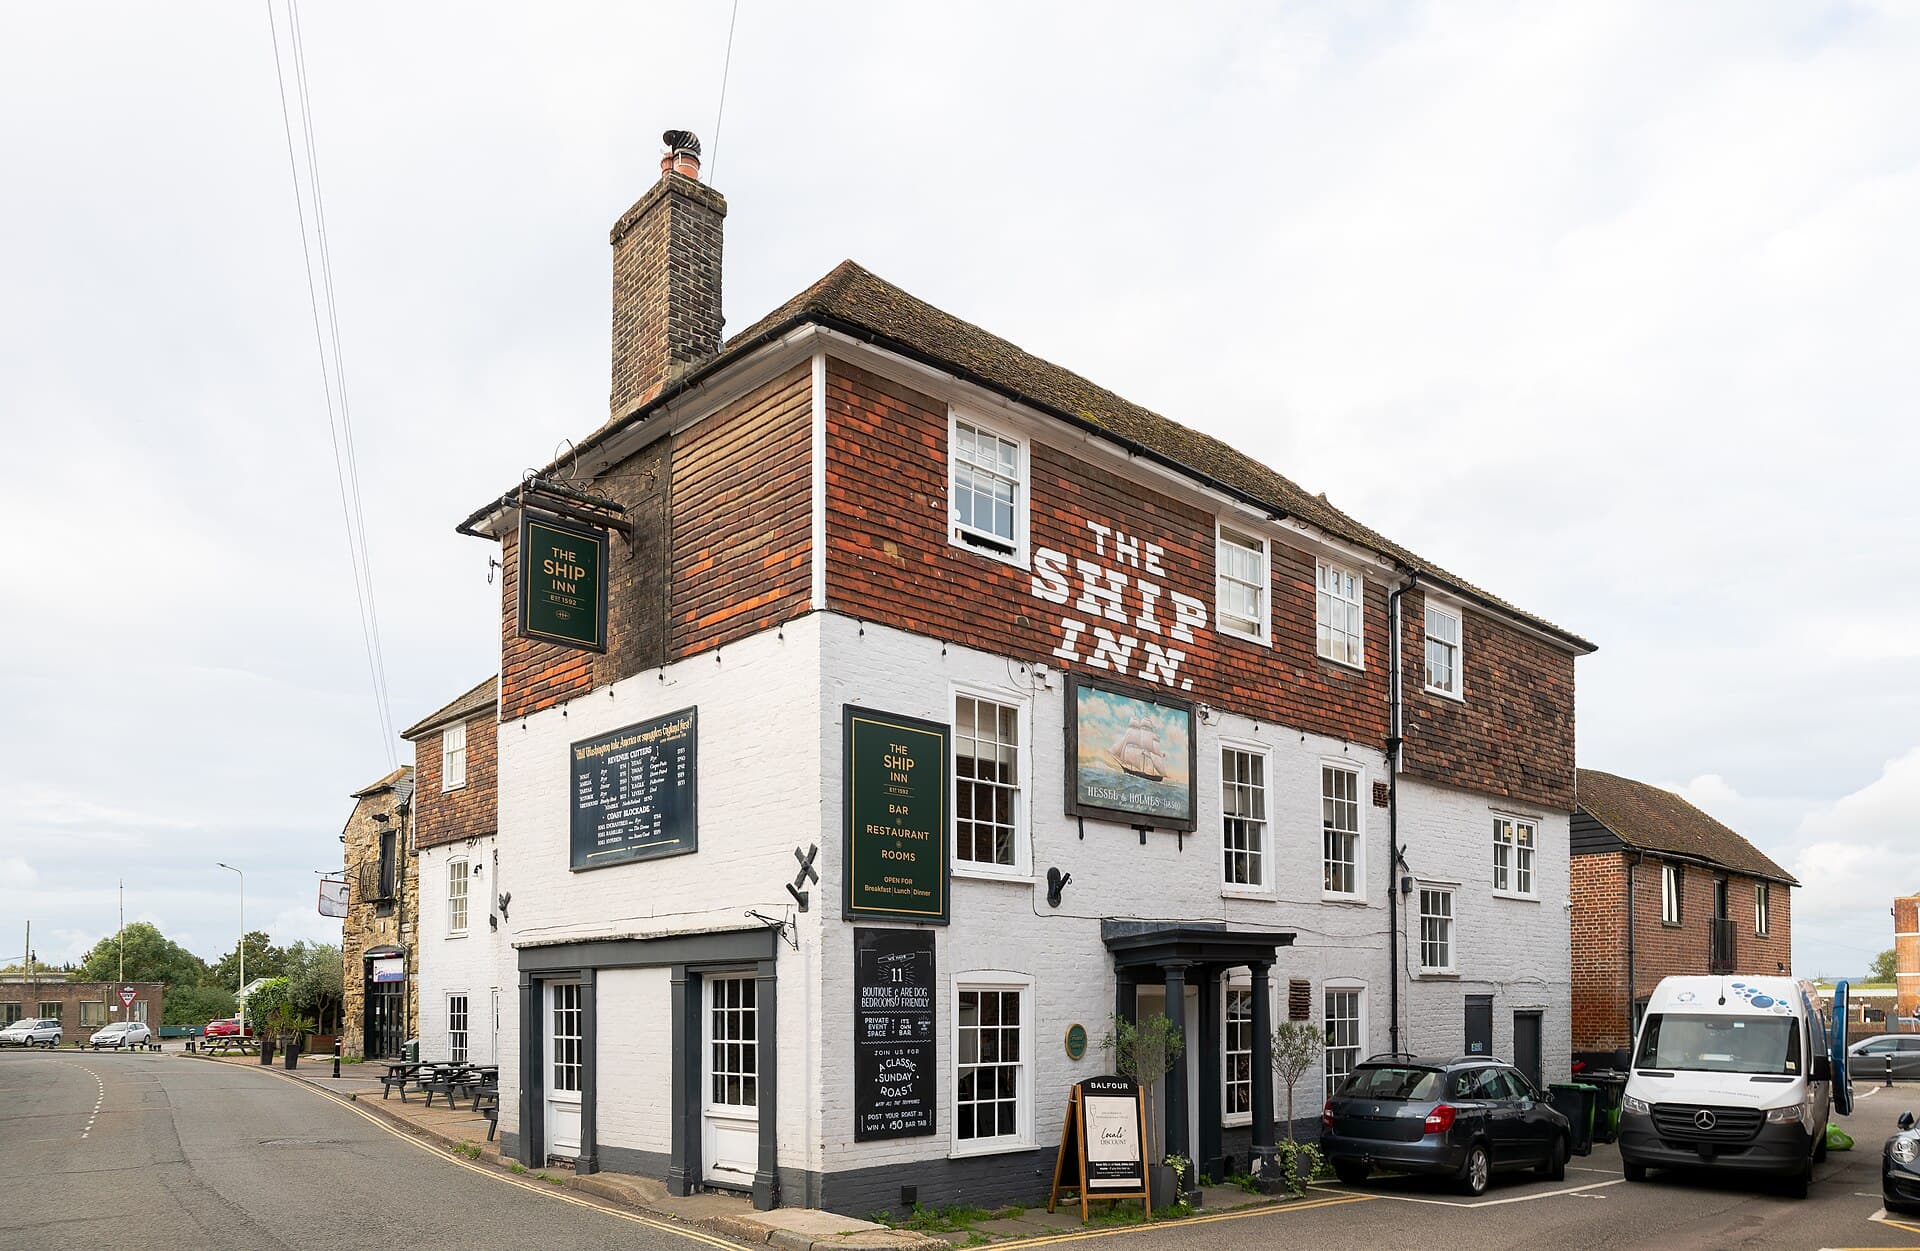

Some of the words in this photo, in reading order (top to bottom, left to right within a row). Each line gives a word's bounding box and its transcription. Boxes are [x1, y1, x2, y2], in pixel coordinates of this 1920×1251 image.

[551, 546, 577, 563] THE
[1086, 519, 1167, 578] THE
[543, 559, 586, 581] SHIP
[552, 579, 576, 595] INN
[1031, 546, 1208, 645] SHIP
[1052, 617, 1194, 691] INN.
[629, 745, 653, 759] CUTTERS
[889, 743, 909, 756] THE
[883, 754, 915, 772] SHIP
[890, 771, 908, 784] INN
[1086, 785, 1119, 802] HESSEL
[1129, 792, 1161, 808] HOLMES
[623, 805, 651, 818] BLOCKADE
[889, 803, 909, 816] BAR
[866, 824, 930, 841] RESTAURANT
[881, 849, 916, 862] ROOMS
[884, 876, 901, 885] OPEN
[901, 877, 913, 886] FOR
[864, 884, 891, 894] Breakfast
[893, 887, 911, 895] Lunch
[912, 888, 931, 897] Dinner
[890, 967, 904, 983] 11
[862, 986, 893, 998] BOUTIQUE
[900, 987, 914, 998] ARE
[914, 987, 928, 998] DOG
[861, 997, 896, 1008] BEDROOMS
[901, 997, 930, 1008] FRIENDLY
[868, 1023, 888, 1031] EVENT
[867, 1030, 887, 1038] SPACE
[879, 1063, 886, 1073] A
[885, 1057, 917, 1072] CLASSIC
[879, 1072, 912, 1083] SUNDAY
[880, 1082, 912, 1097] ROAST
[867, 1112, 883, 1121] POST
[884, 1111, 899, 1119] YOUR
[900, 1110, 917, 1118] ROAST
[866, 1123, 879, 1131] WIN
[880, 1122, 886, 1130] A
[904, 1120, 916, 1129] BAR
[916, 1119, 927, 1127] TAB
